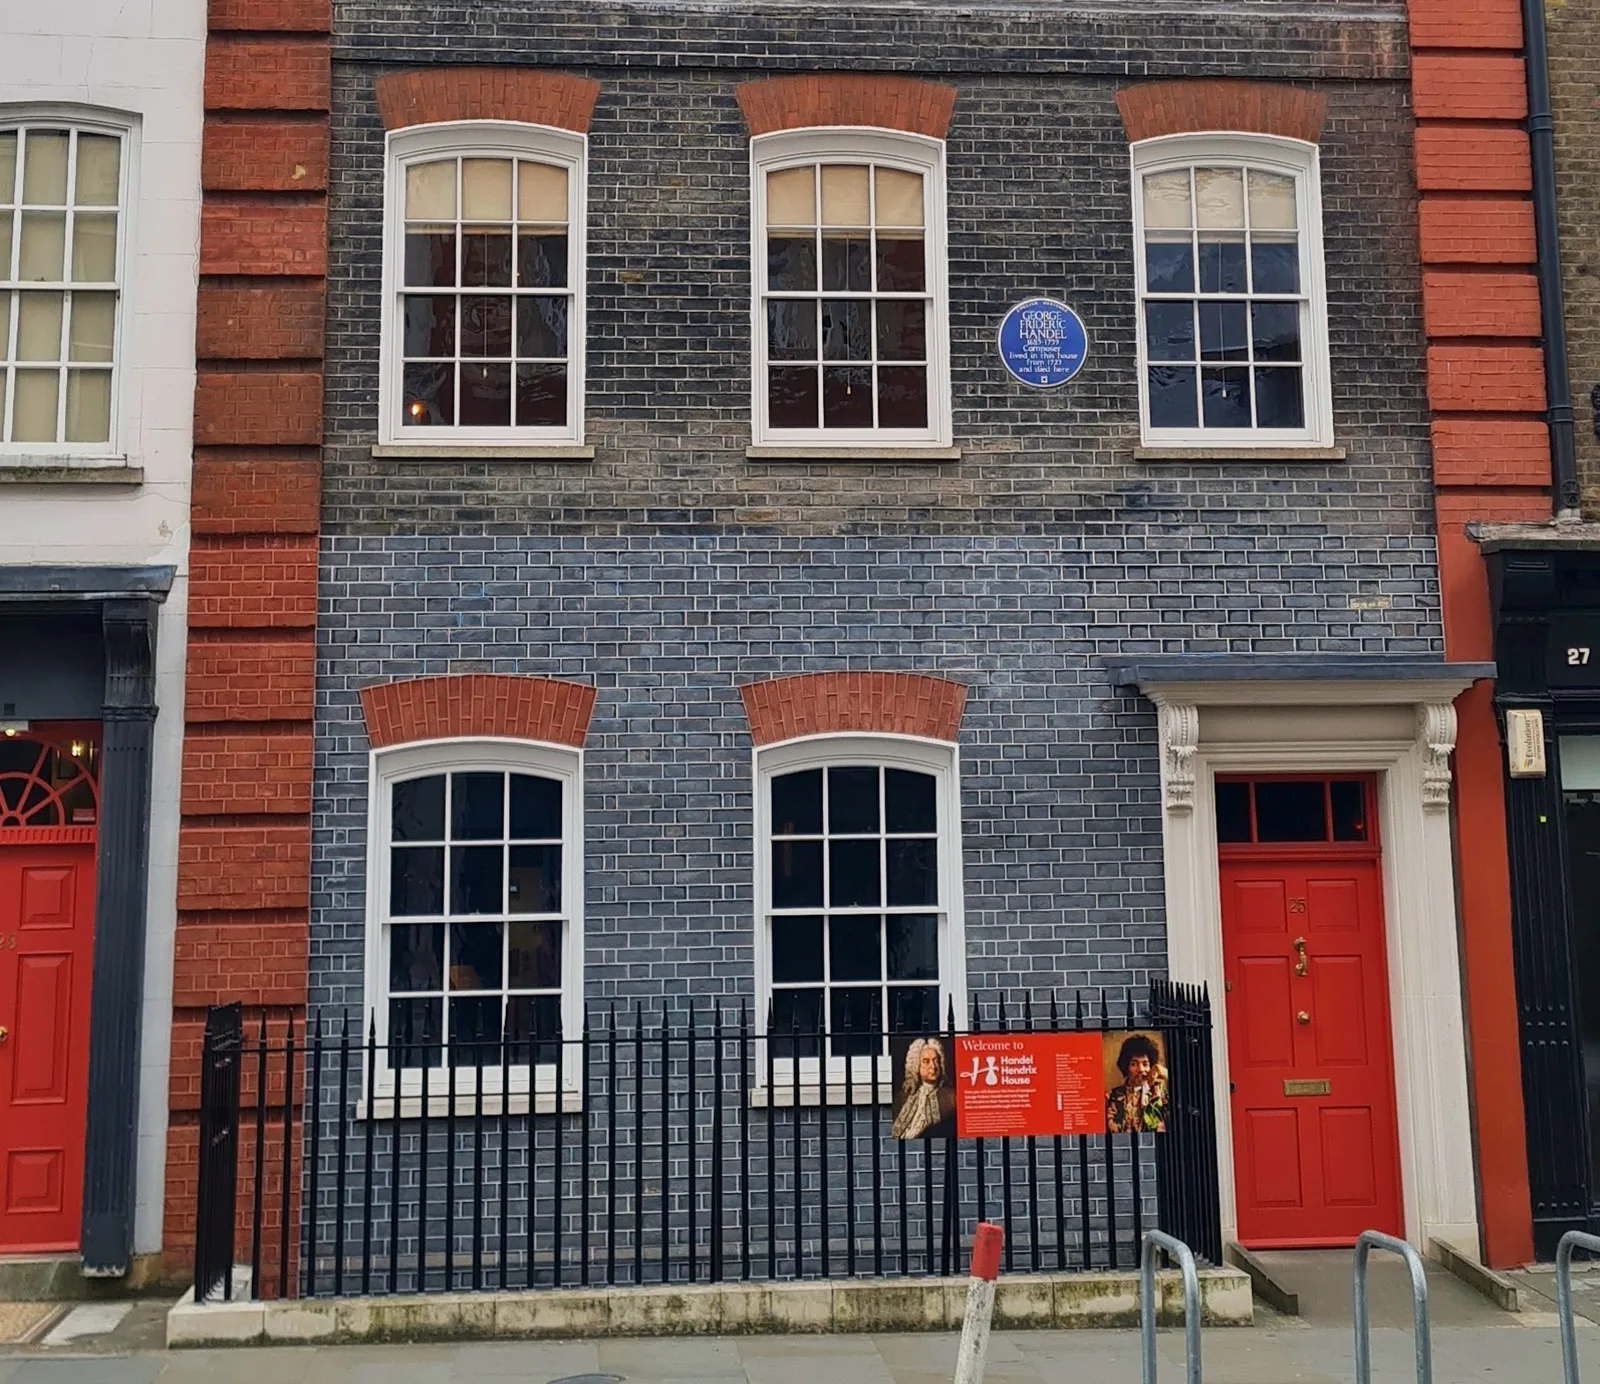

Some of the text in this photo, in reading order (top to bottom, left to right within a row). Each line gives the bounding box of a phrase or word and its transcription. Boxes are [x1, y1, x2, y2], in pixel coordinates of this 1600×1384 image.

[1022, 311, 1062, 320] GEORGE
[1020, 320, 1066, 329] FRIDERIC
[1020, 329, 1067, 339] HANDEL
[1022, 345, 1062, 353] Composer
[1057, 352, 1078, 360] house
[1567, 647, 1590, 665] 27
[1524, 719, 1534, 758] Evolution
[1289, 897, 1306, 914] 25
[962, 1040, 1024, 1051] Welcome to
[1001, 1055, 1034, 1065] Handel
[1001, 1065, 1037, 1075] Hendrix
[1001, 1076, 1031, 1085] House
